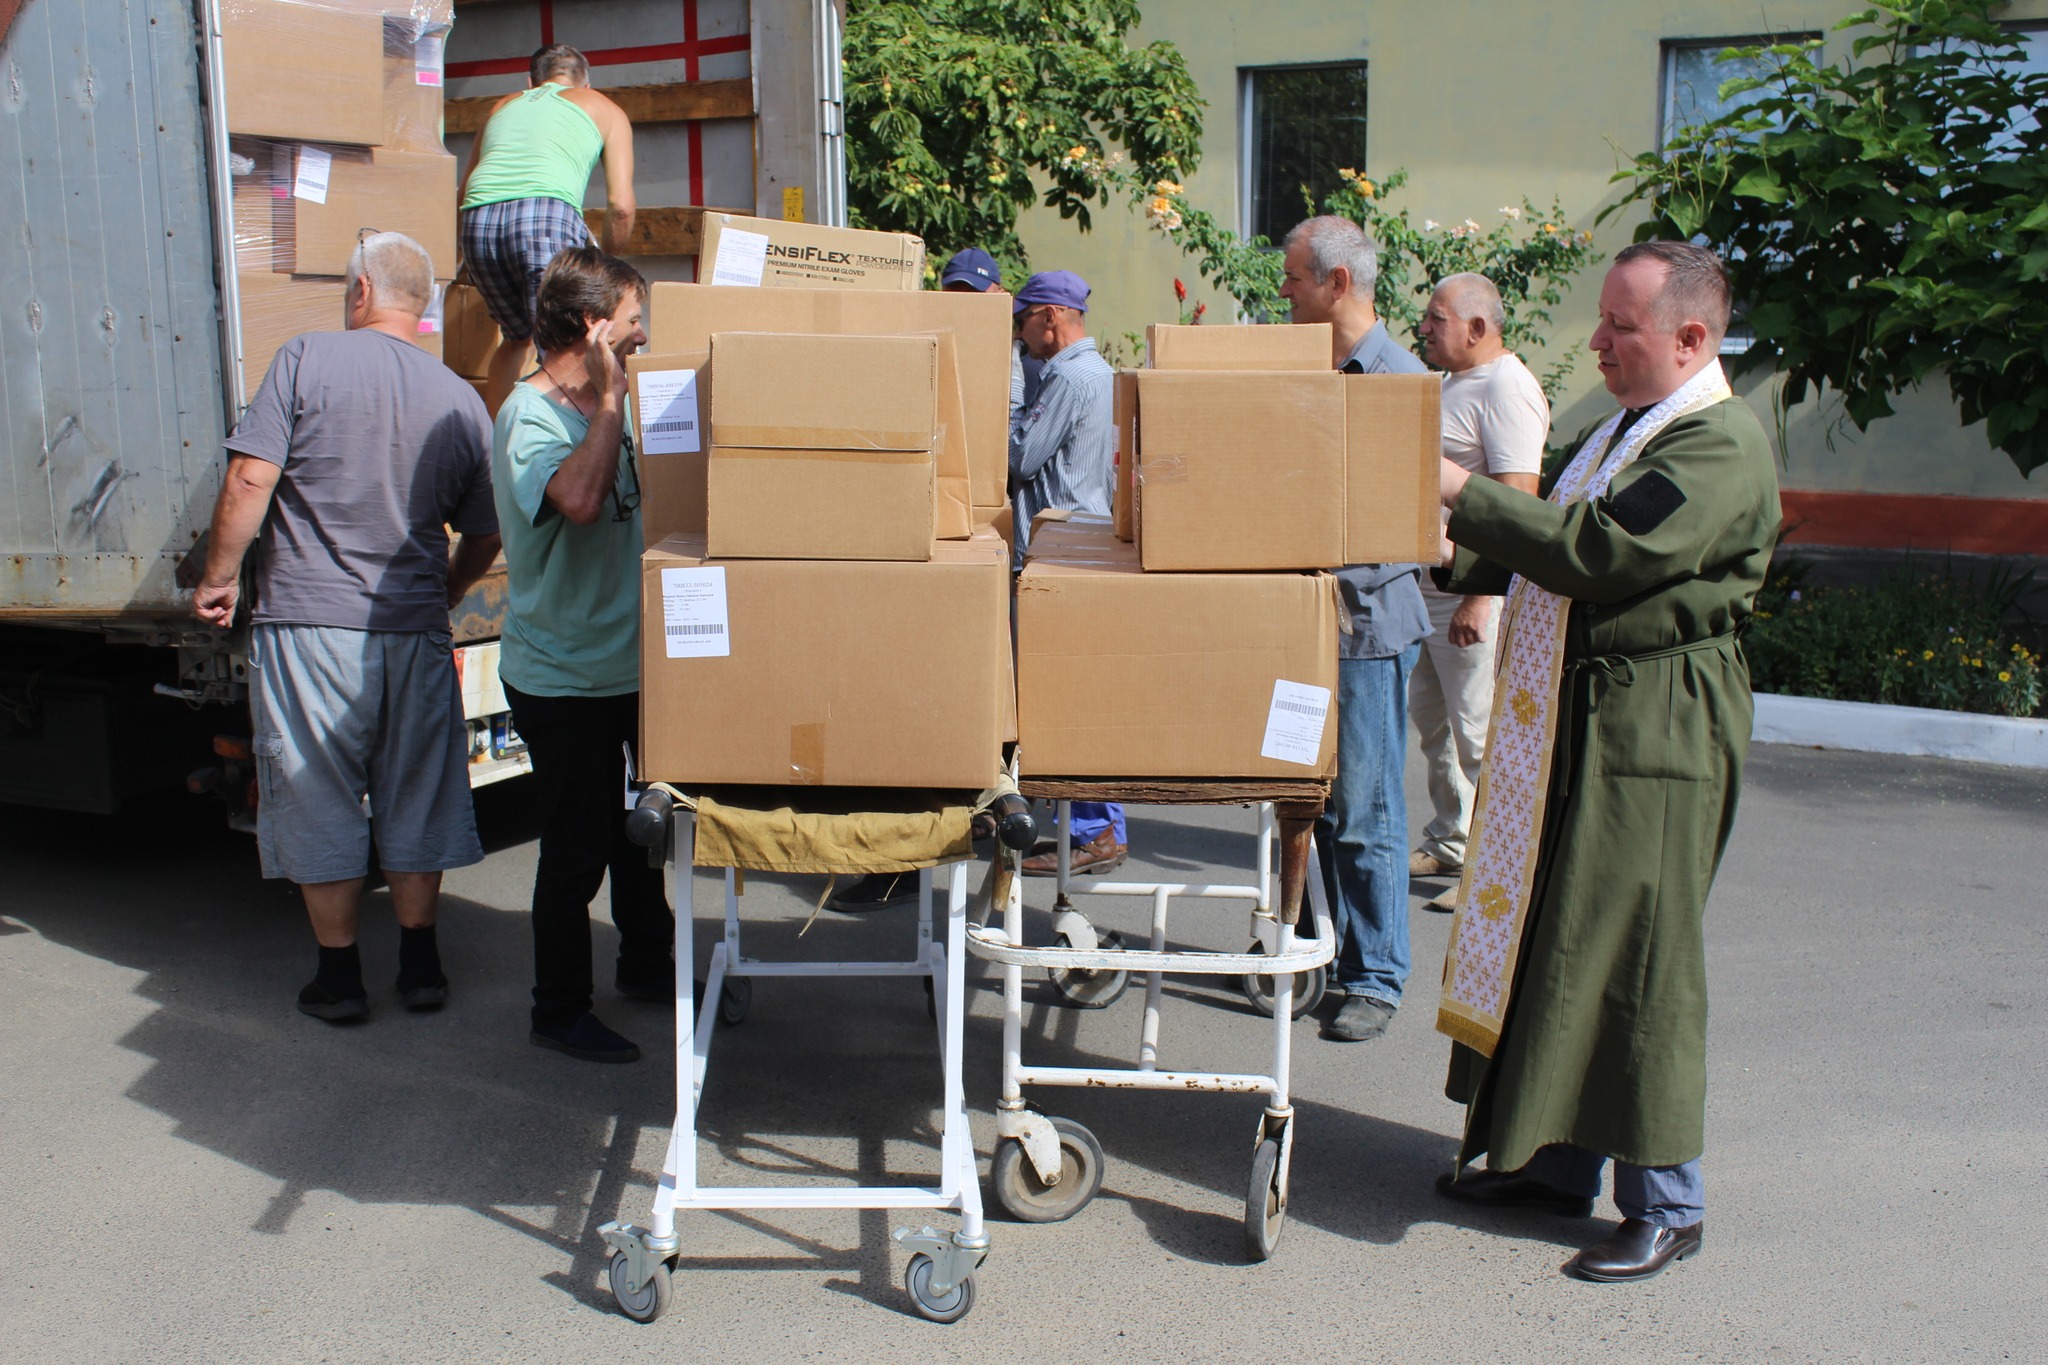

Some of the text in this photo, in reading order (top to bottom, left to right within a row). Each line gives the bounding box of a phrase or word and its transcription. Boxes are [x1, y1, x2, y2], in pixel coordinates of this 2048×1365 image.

[766, 244, 914, 267] ENSIFLEX TEXTURED
[767, 259, 866, 277] PREMIUM NITRILE EXAM GLOVES
